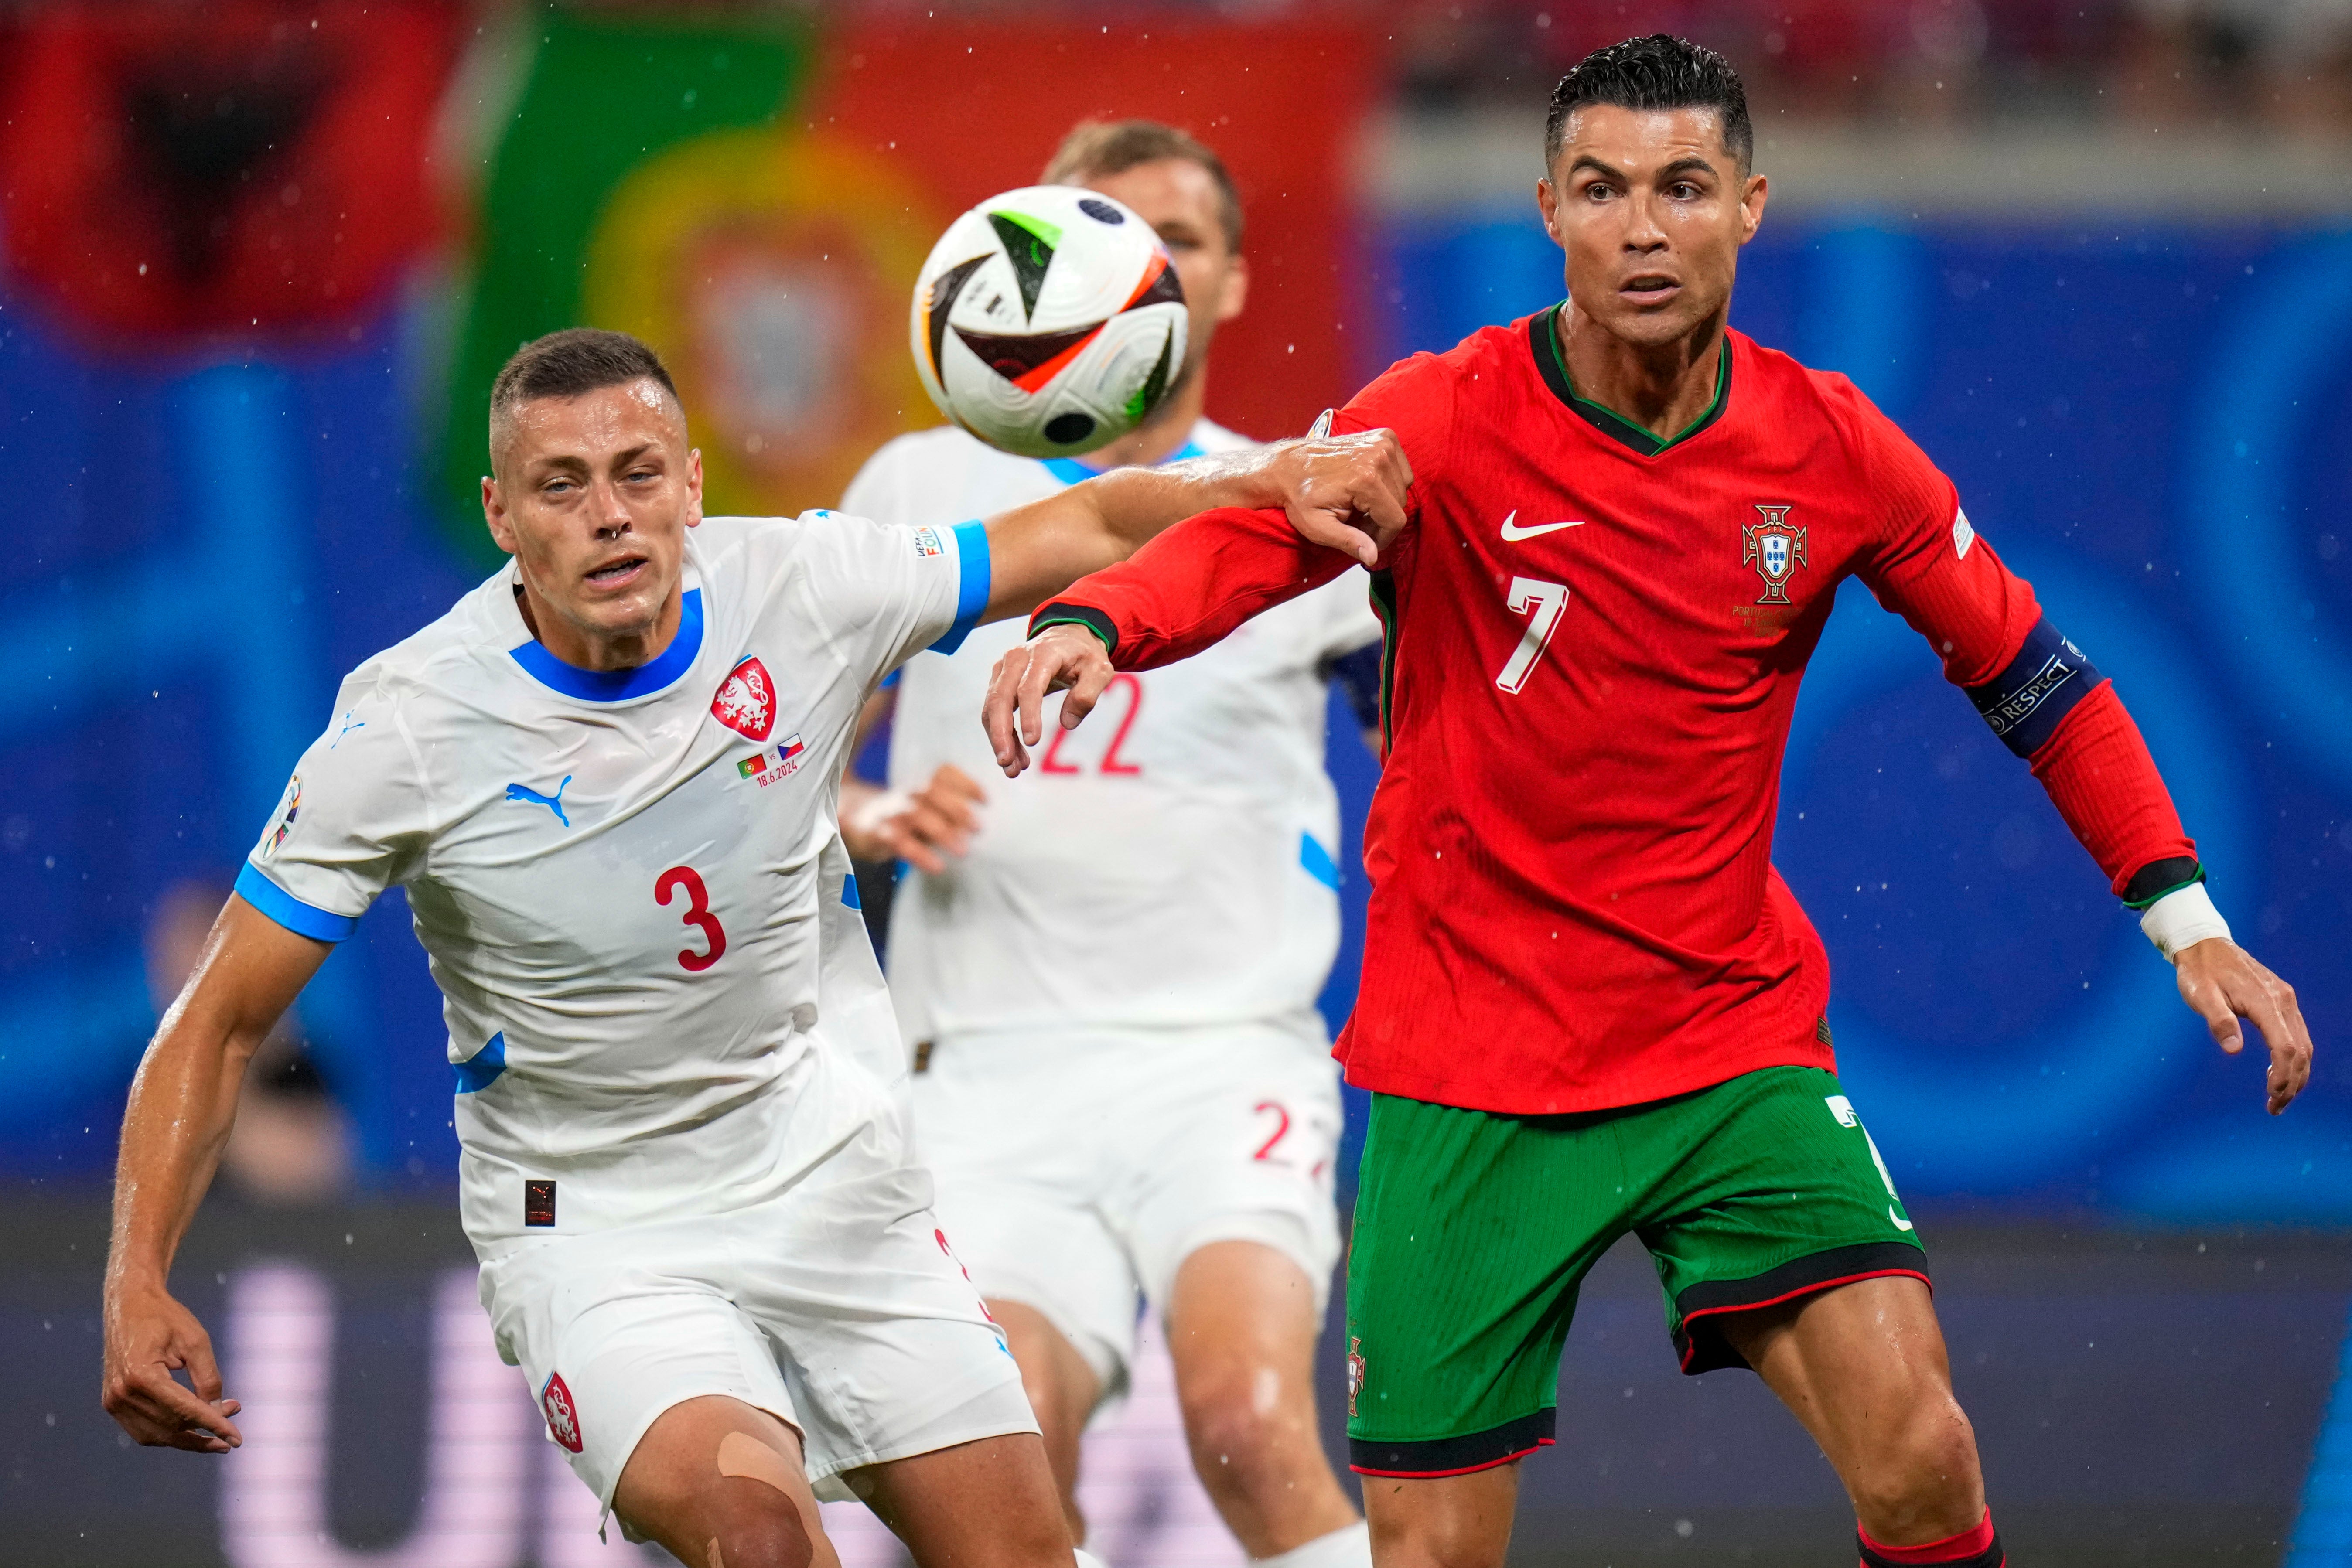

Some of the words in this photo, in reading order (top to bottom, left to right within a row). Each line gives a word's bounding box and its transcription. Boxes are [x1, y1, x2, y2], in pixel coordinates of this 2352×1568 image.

[915, 537, 925, 557] UEFA
[1496, 576, 1569, 695] 7
[2002, 658, 2069, 719] RESPECT
[757, 760, 798, 788] 18.6.2024
[655, 866, 726, 971] 3
